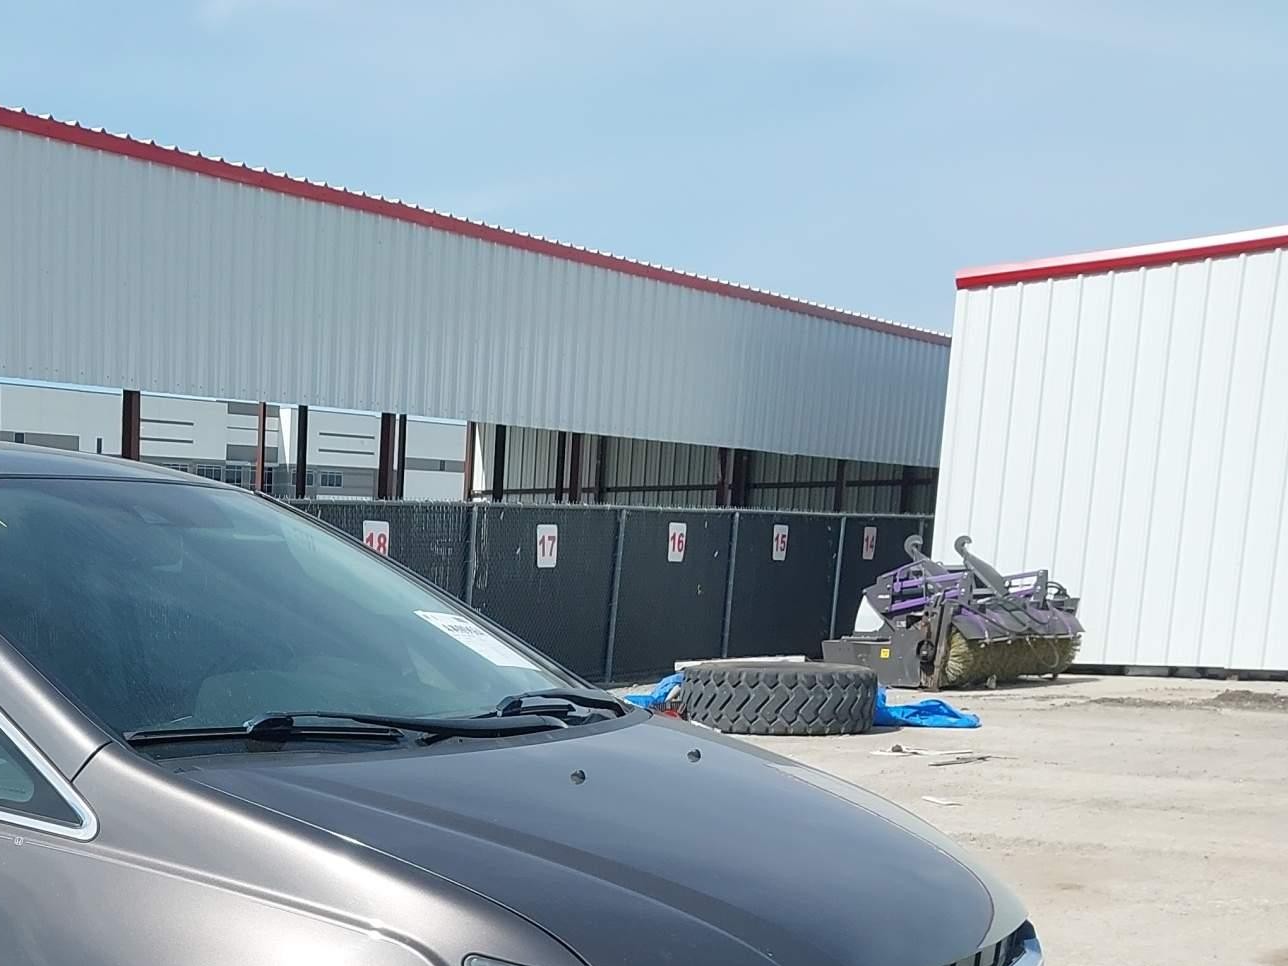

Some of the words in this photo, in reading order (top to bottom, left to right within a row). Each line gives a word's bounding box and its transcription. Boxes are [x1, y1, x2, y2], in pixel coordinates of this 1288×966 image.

[366, 532, 387, 555] 18
[538, 534, 557, 558] 17
[670, 532, 685, 553] 16
[774, 533, 787, 552] 15
[864, 535, 875, 553] 14
